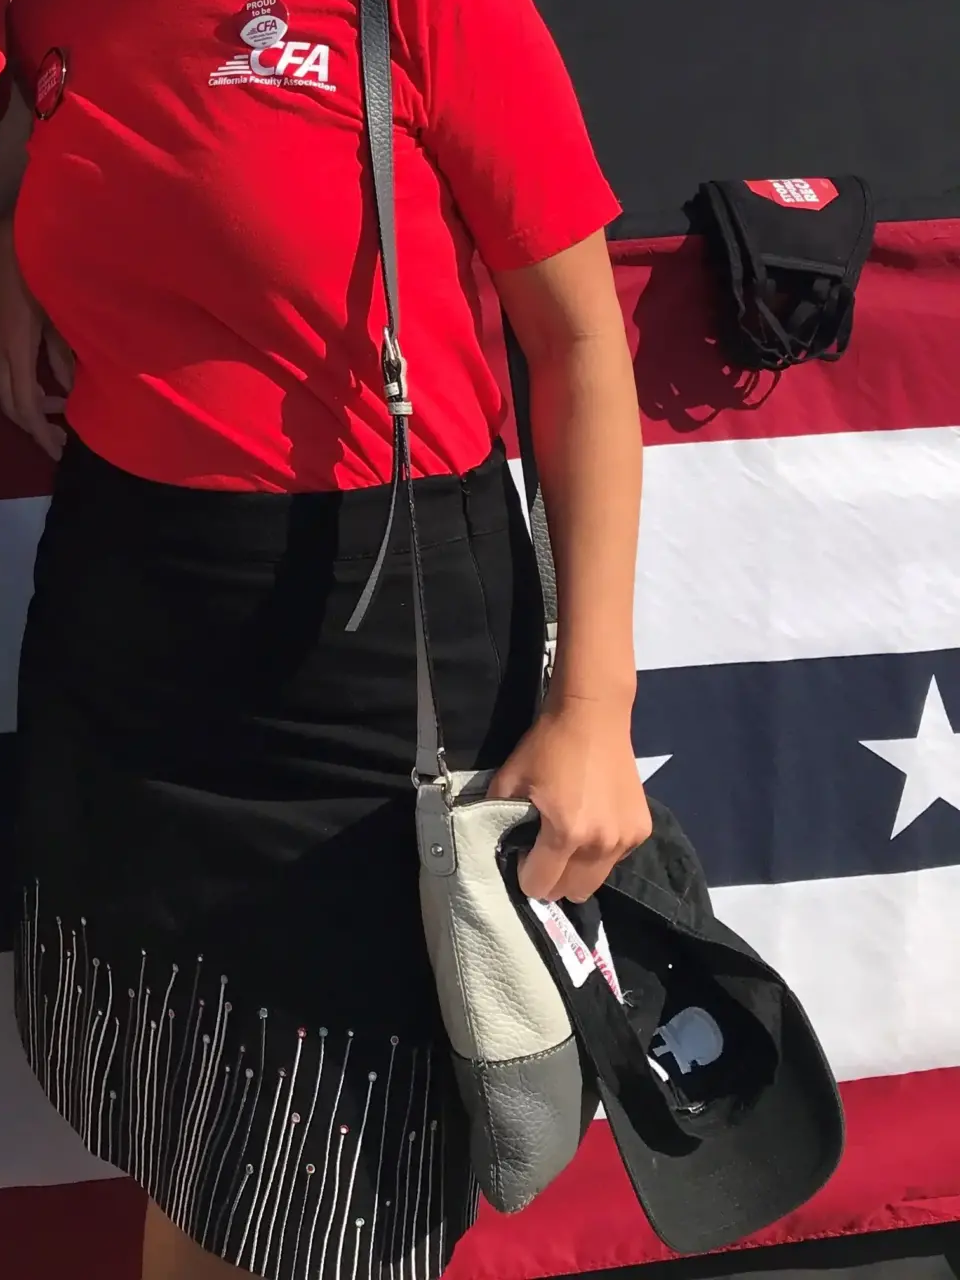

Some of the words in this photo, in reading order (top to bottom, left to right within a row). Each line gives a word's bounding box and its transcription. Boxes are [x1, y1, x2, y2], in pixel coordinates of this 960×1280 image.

[251, 9, 260, 17] to
[261, 7, 271, 16] be
[256, 19, 278, 33] CFA
[250, 41, 329, 82] CFA
[208, 76, 247, 86] California
[249, 75, 282, 87] Faculty
[283, 78, 337, 92] Association
[772, 181, 795, 203] STOP
